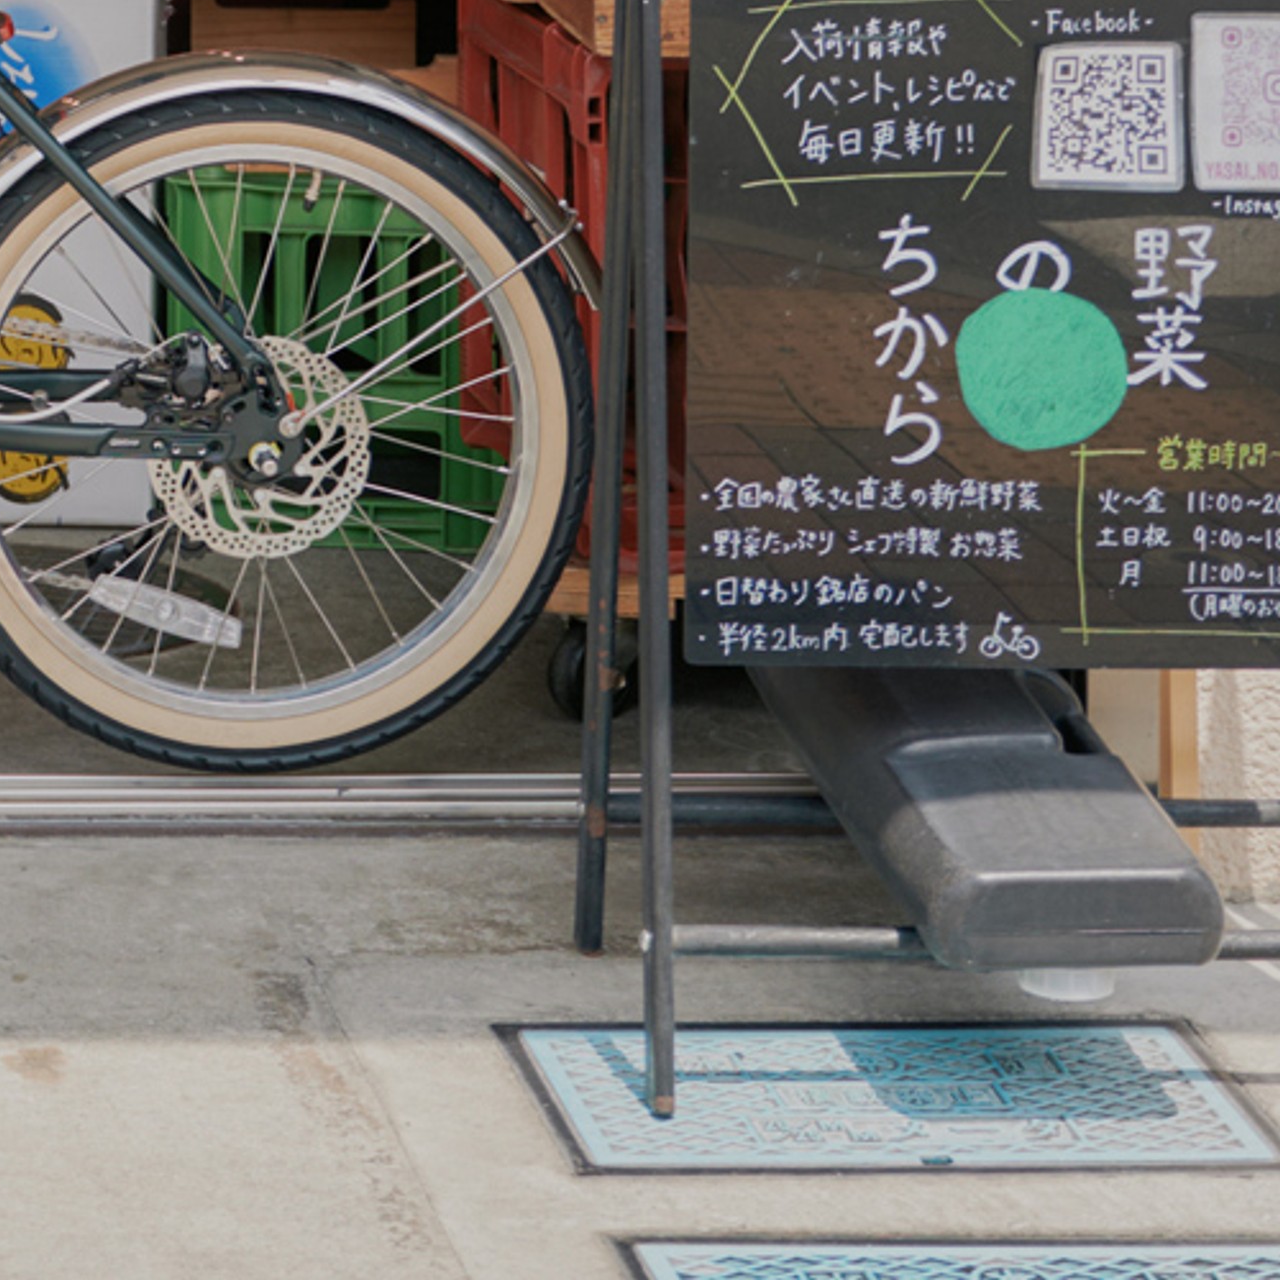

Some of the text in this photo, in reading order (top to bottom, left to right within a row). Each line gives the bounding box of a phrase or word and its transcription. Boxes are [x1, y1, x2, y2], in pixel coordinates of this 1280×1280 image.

[780, 16, 947, 66] 入荷情報や
[1045, 8, 1141, 35] Facebook
[782, 68, 1017, 113] イベント、レシピなど
[798, 117, 975, 165] 毎日更新!!
[1204, 161, 1280, 181] YASAI_NO
[996, 240, 1073, 293] の
[1127, 224, 1218, 391] 野菜
[873, 213, 949, 467] ちから
[1156, 433, 1268, 471] 営業時間
[713, 473, 1044, 513] 全国の農家さん直送の新鮮野菜
[712, 525, 1025, 562] 野菜たっぷり シェフ特製 お惣菜
[1095, 521, 1172, 550] 土日祝
[715, 573, 954, 609] 日替わり銘店のパン
[1118, 559, 1280, 588] 月 11:00〜1
[718, 618, 971, 657] 半径2km内 宅配します
